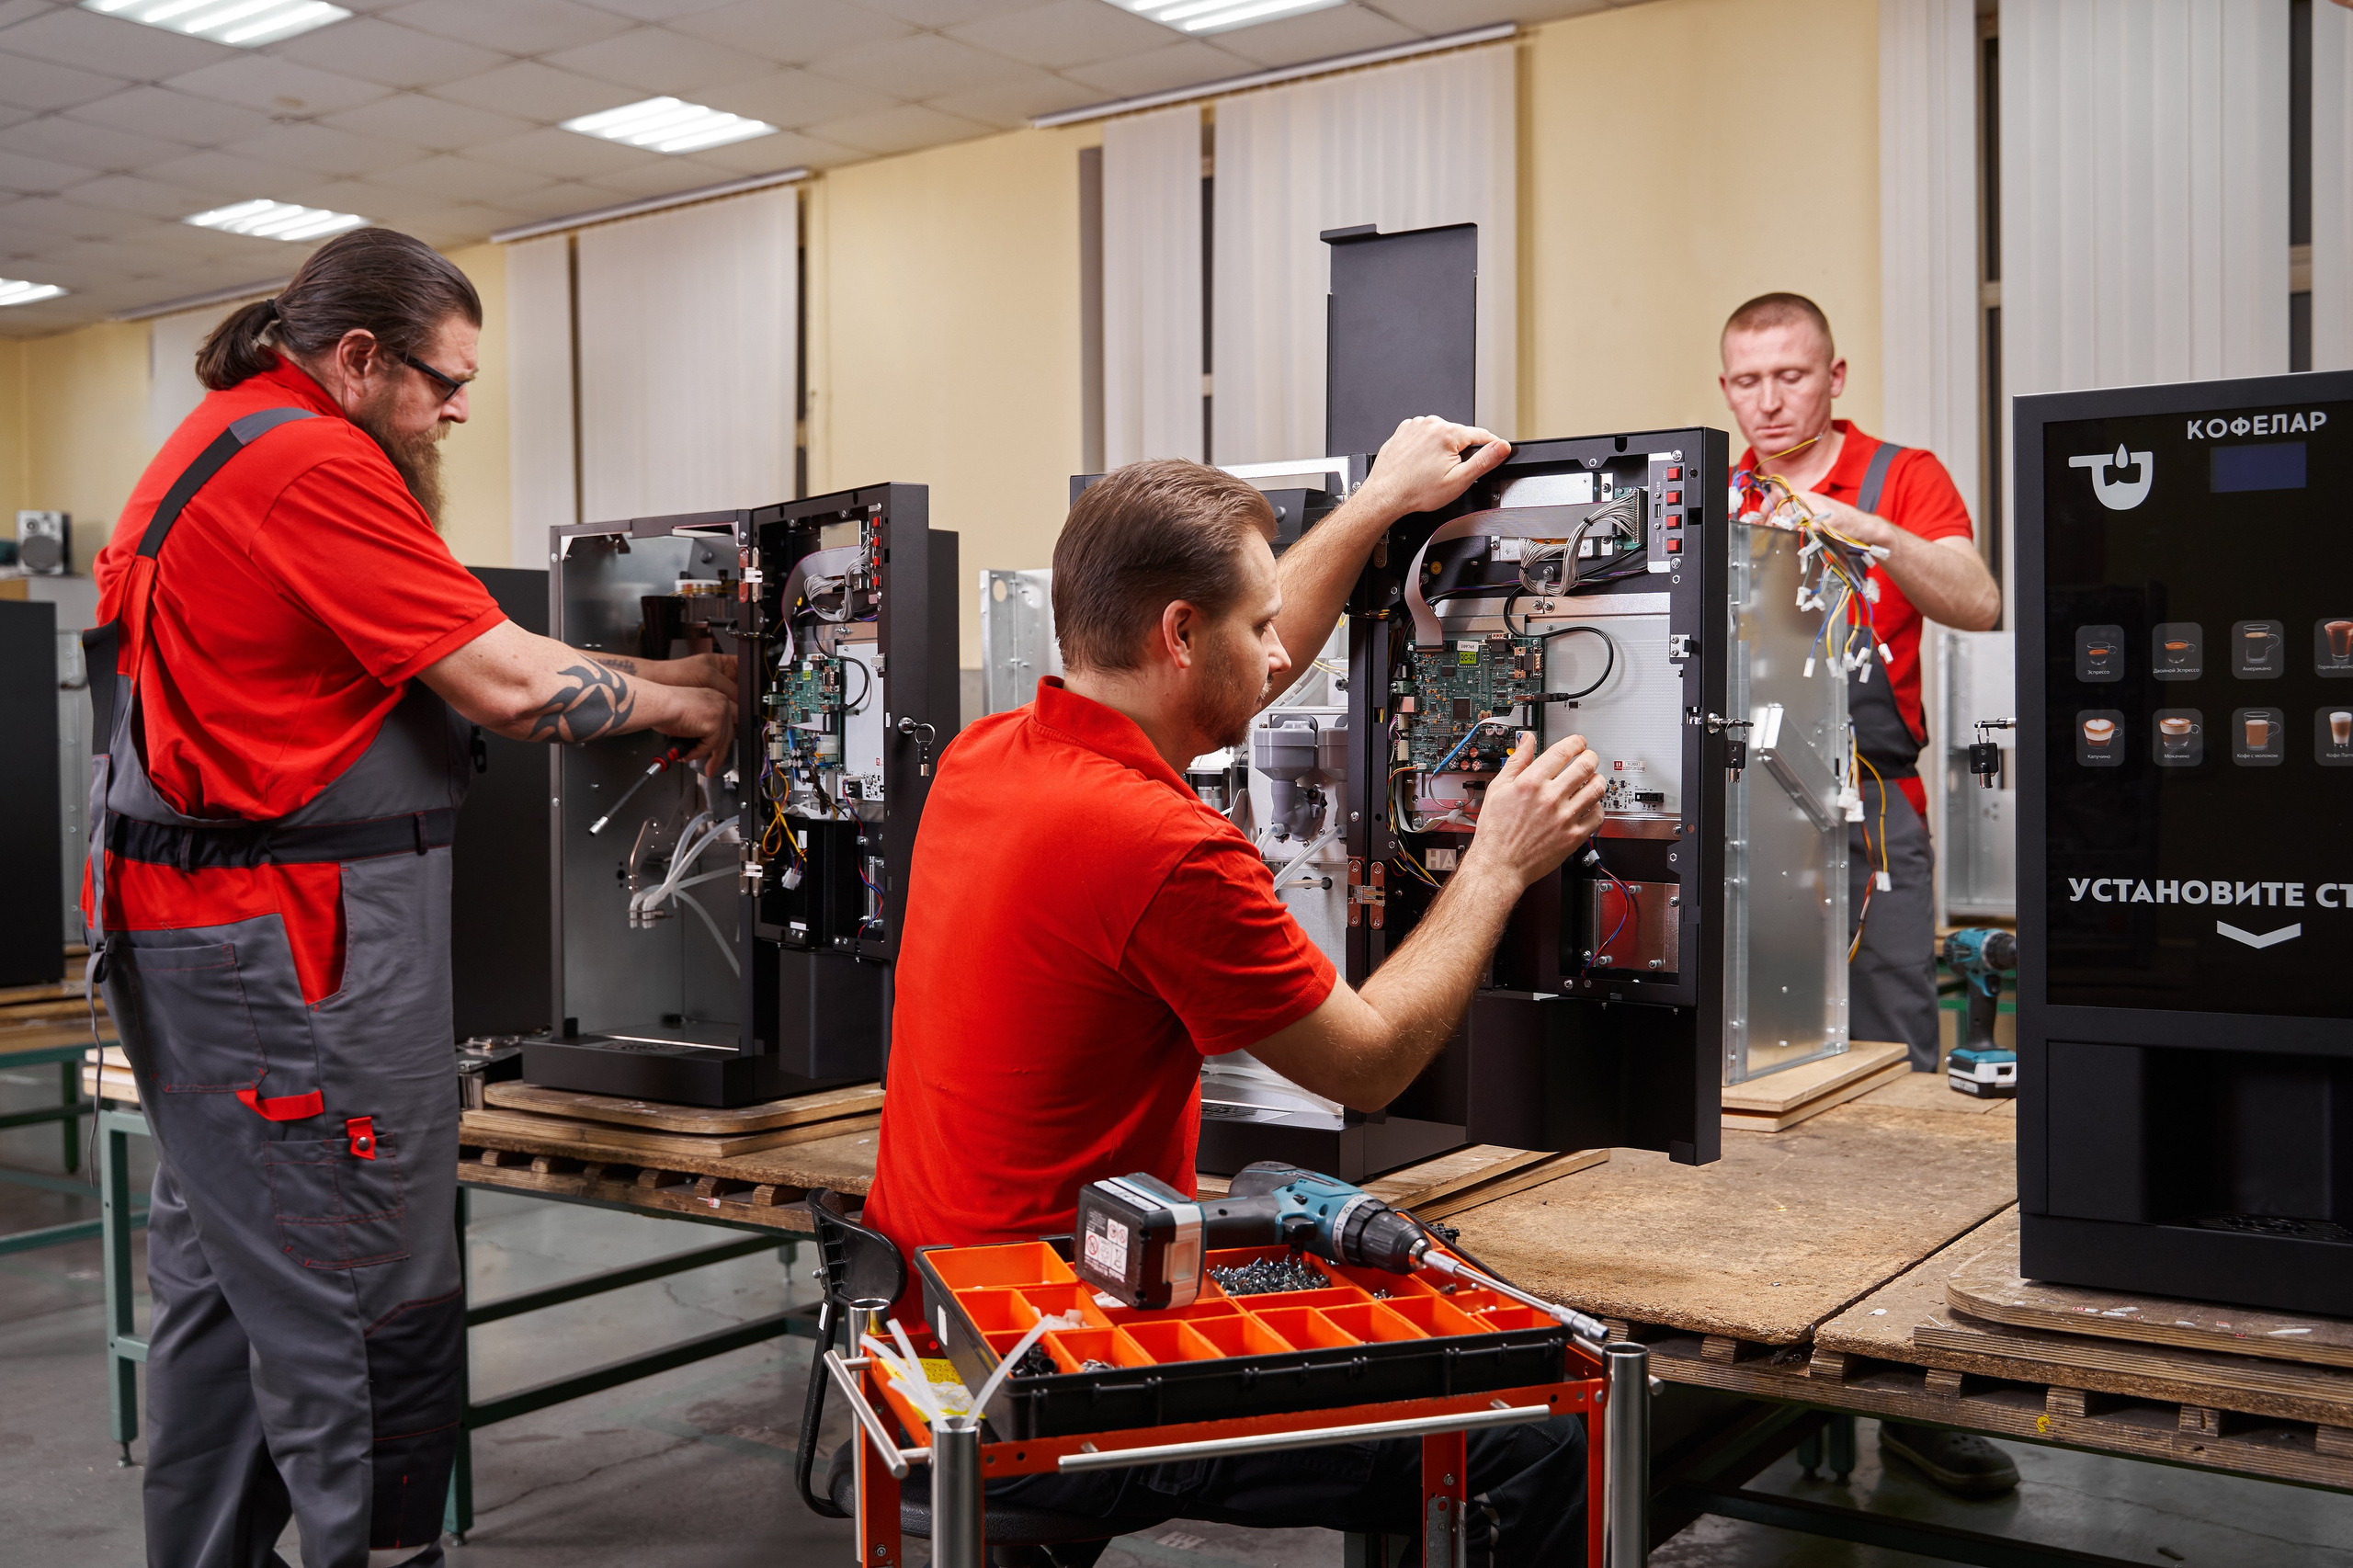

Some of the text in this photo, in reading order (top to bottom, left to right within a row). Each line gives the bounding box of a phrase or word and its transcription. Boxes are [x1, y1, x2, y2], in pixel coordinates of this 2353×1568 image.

[2187, 411, 2328, 439] КОФЕЛАР
[1460, 653, 1476, 662] QC-27
[2068, 878, 2353, 908] УСТАНОВИТЕ СТ
[1342, 1206, 1352, 1214] 12
[1336, 1222, 1343, 1232] 14
